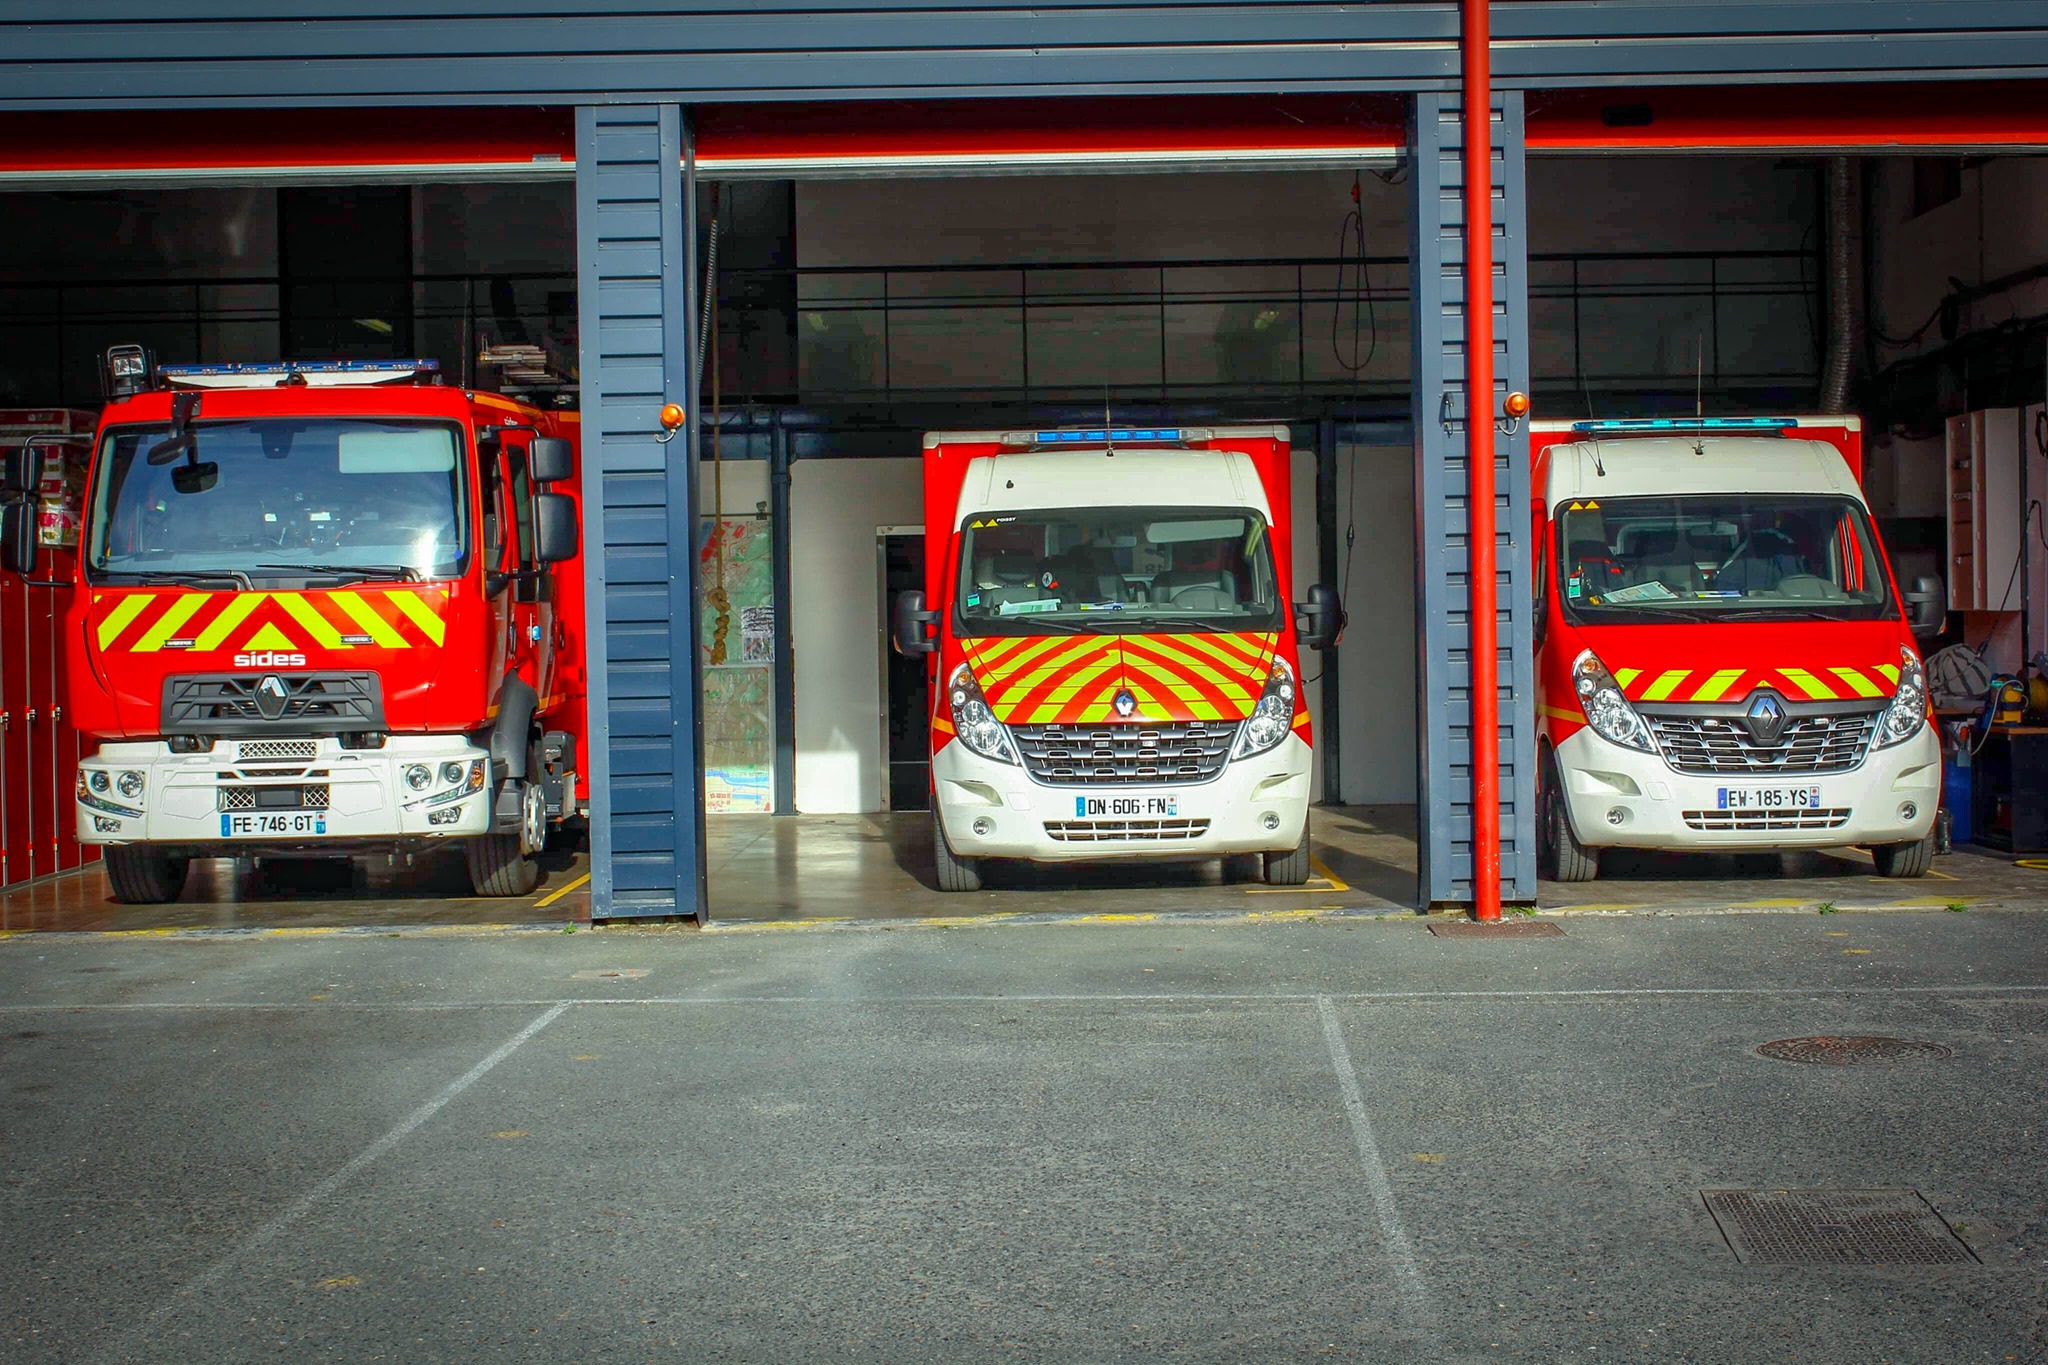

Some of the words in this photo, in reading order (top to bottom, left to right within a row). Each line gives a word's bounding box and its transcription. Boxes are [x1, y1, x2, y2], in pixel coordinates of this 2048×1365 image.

[233, 651, 306, 667] sides
[1088, 798, 1166, 815] DN-606-FN
[1728, 789, 1808, 807] EW-185-YS
[1810, 797, 1819, 805] 78
[233, 815, 313, 833] FE-746-GT
